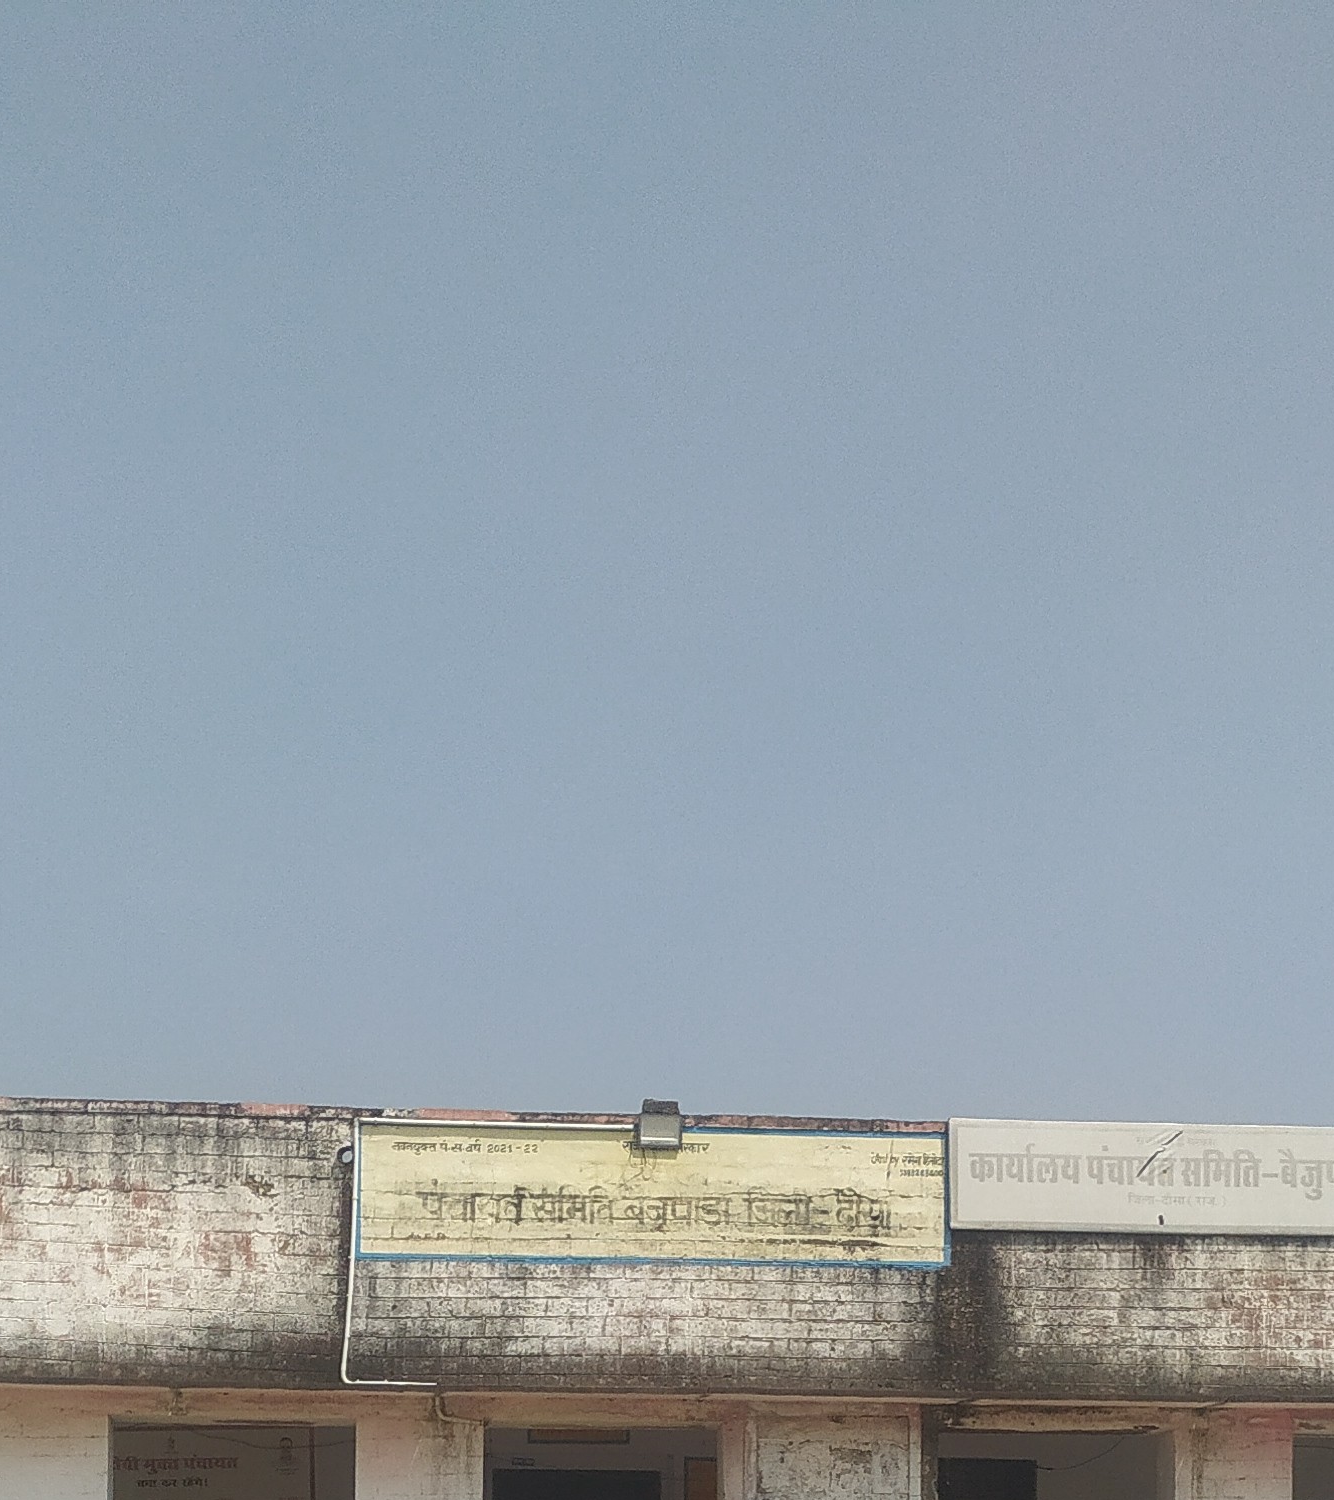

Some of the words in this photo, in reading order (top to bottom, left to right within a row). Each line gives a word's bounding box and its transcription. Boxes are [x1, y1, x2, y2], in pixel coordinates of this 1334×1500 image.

[968, 1142, 1083, 1184] कार्यालय
[1085, 1145, 1177, 1187] पंचायत
[182, 1454, 240, 1471] पंचायत
